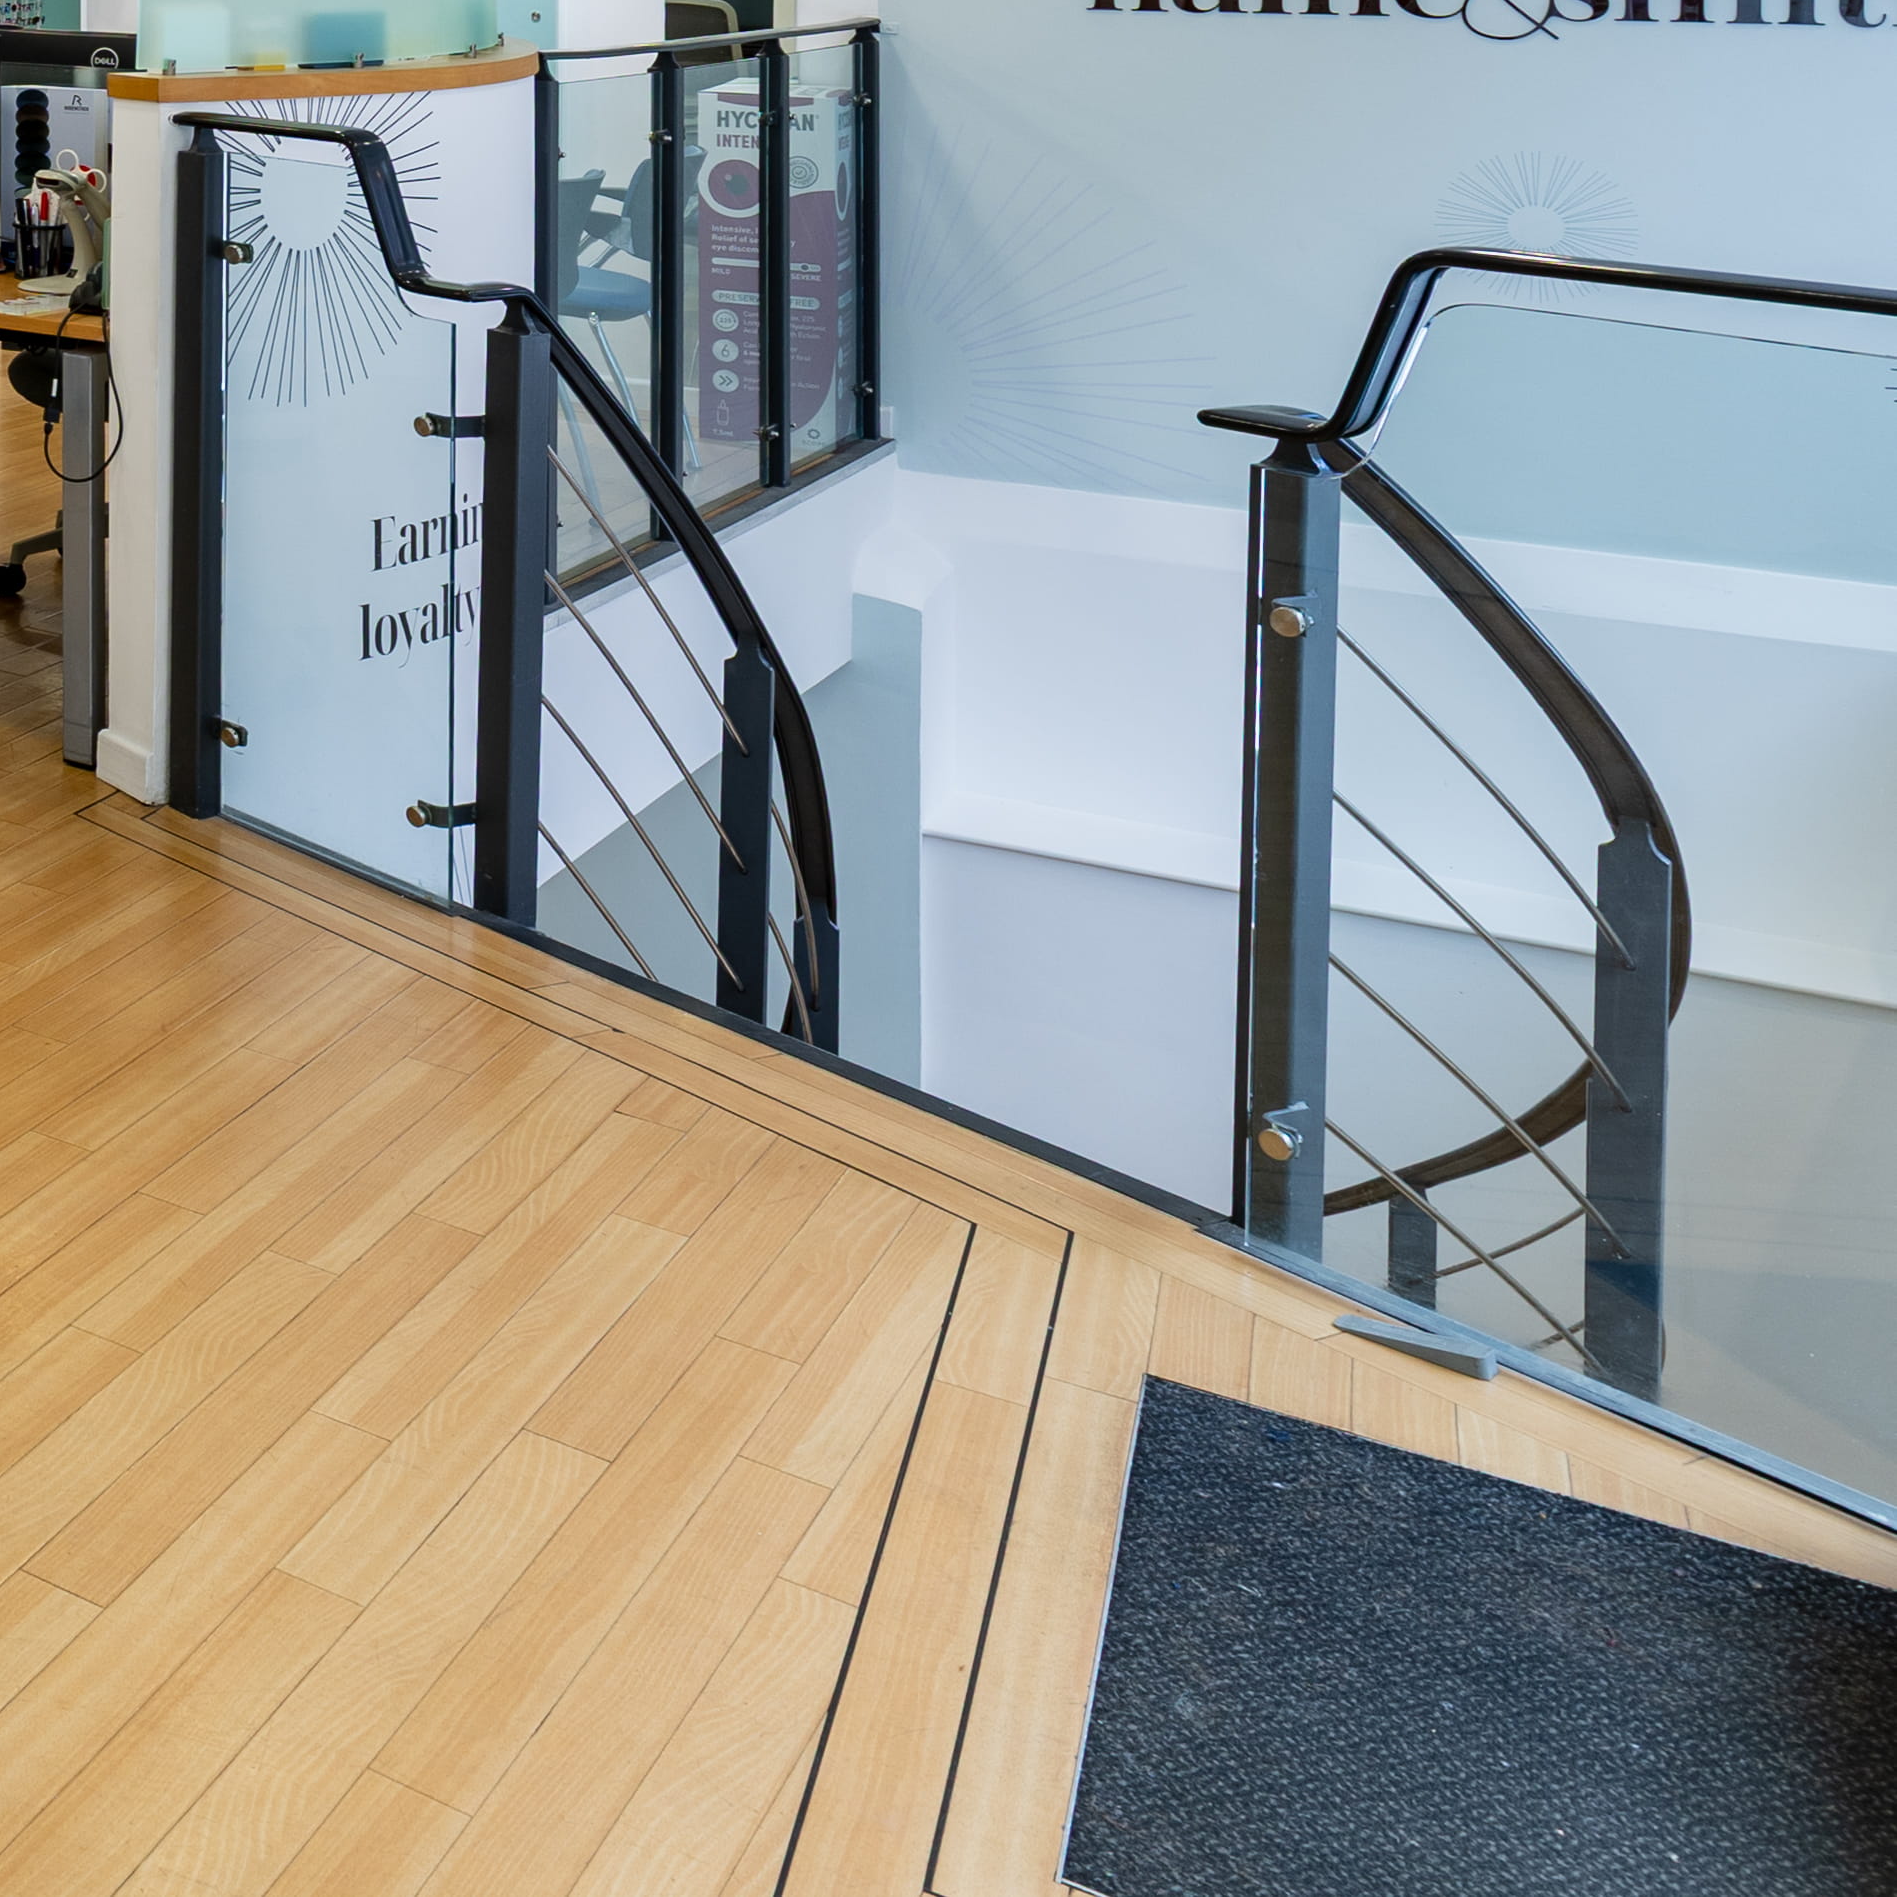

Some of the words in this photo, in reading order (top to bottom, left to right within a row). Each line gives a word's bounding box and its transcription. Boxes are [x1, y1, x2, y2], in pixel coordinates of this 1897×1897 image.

[95, 57, 115, 65] DELL
[717, 110, 815, 132] HYCAN
[716, 134, 760, 149] INTEN
[729, 244, 760, 254] discom
[721, 343, 730, 358] 6
[358, 581, 481, 669] loyalty
